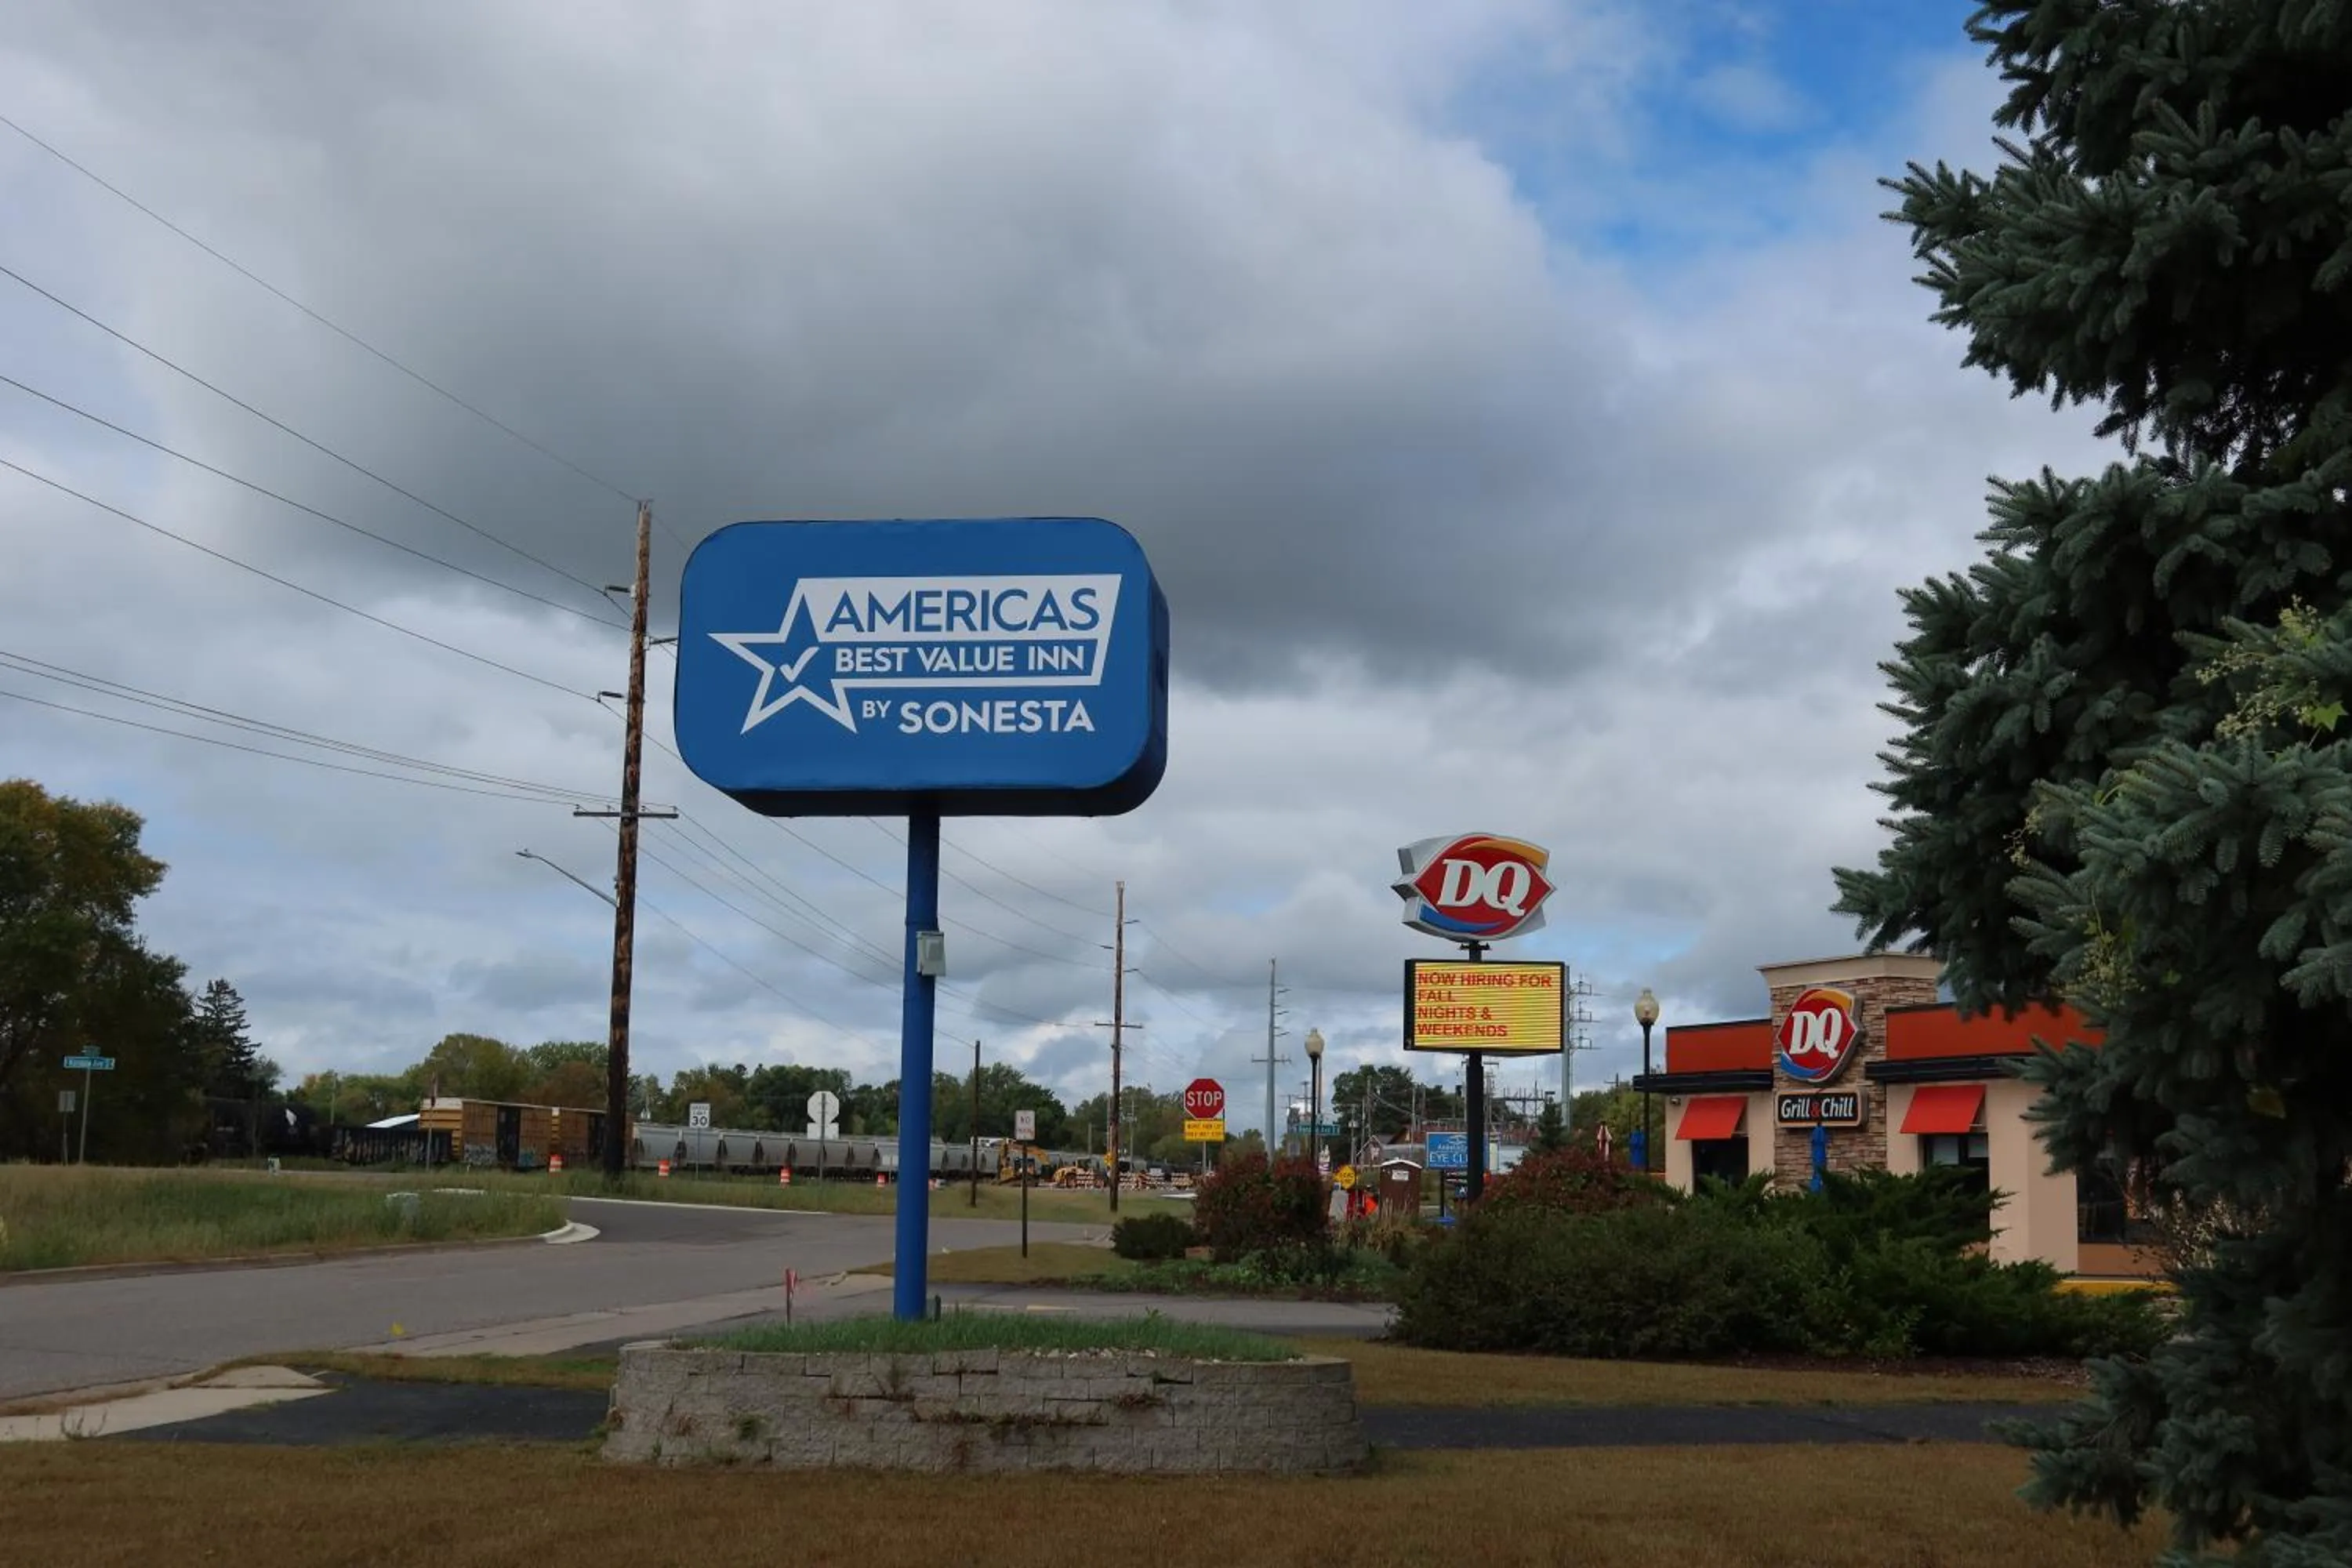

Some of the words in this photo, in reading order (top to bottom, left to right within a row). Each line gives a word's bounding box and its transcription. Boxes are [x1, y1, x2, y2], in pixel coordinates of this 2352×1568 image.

[825, 588, 1099, 633] AMERICAS
[835, 647, 909, 673] BEST
[916, 646, 1014, 672] VALUE
[1028, 645, 1084, 670] INN
[862, 700, 891, 718] BY
[898, 699, 1095, 734] SONESTA
[1436, 858, 1530, 916] DQ
[1417, 972, 1455, 985] NOW
[1461, 974, 1513, 987] HIRING
[1519, 975, 1552, 987] FOR
[1417, 989, 1455, 1001] FALL
[1417, 1007, 1475, 1019] NIGHTS
[1481, 1007, 1492, 1020] &
[1417, 1024, 1508, 1036] WEEKENDS
[1789, 1007, 1842, 1058] DQ
[1186, 1091, 1222, 1106] STOP
[691, 1116, 708, 1127] 30
